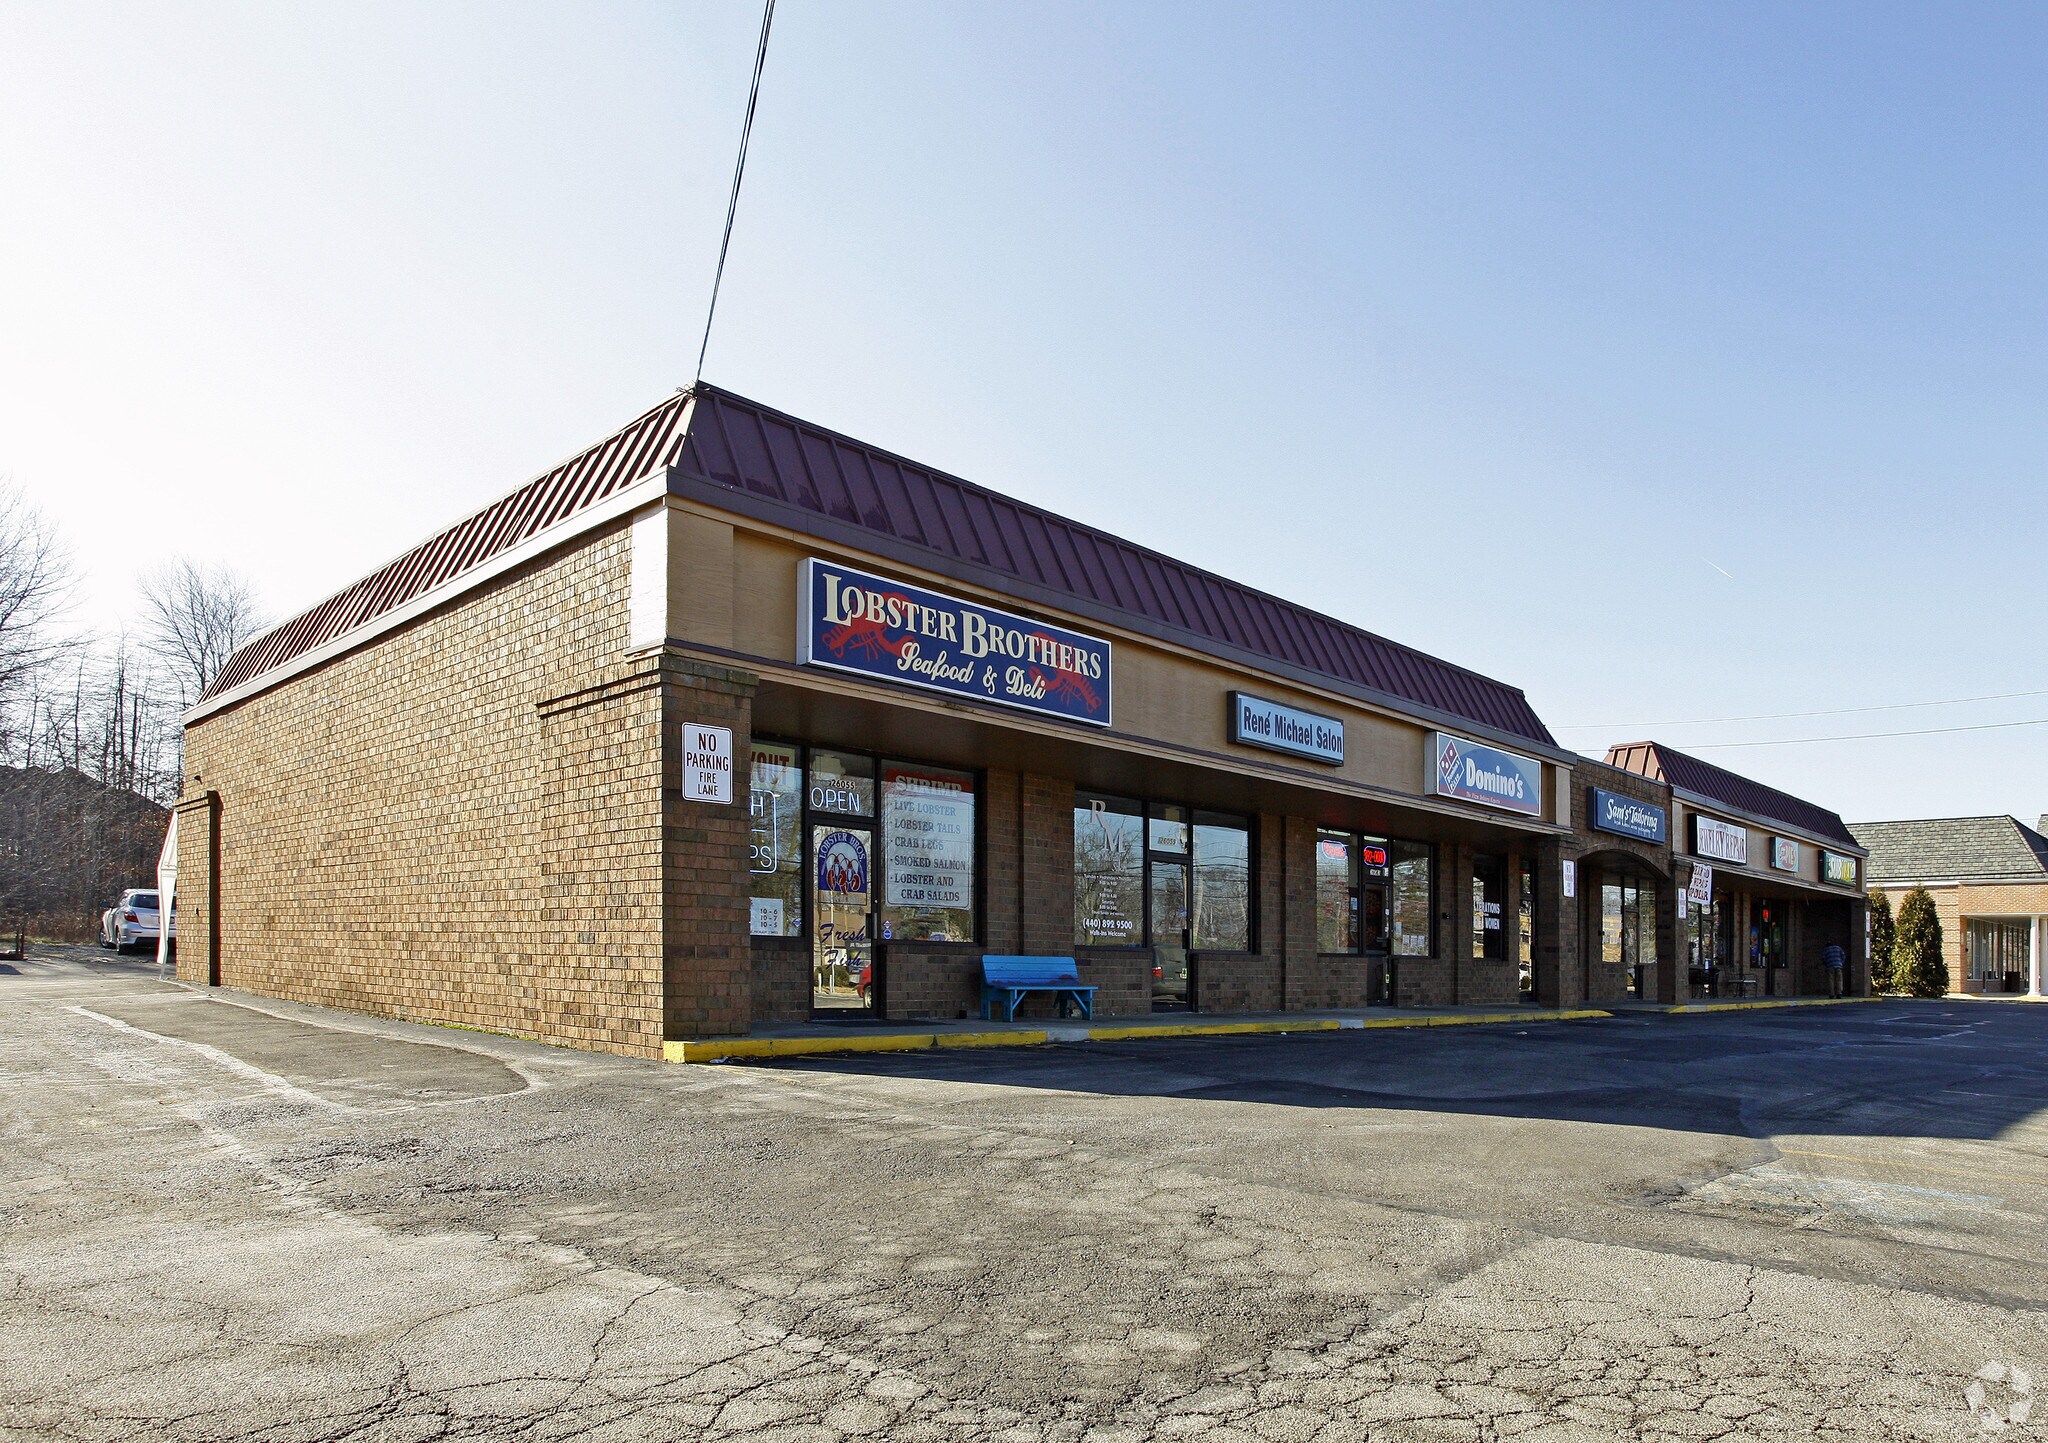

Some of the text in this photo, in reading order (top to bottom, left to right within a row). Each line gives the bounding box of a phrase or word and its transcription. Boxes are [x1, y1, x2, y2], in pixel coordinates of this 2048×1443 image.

[823, 573, 1101, 680] LOBSTER BROTHERS
[897, 642, 1046, 700] Seafood & Deli
[1244, 706, 1342, 753] René Michael Salon
[698, 733, 716, 752] NO
[686, 752, 729, 771] PARKING
[700, 772, 716, 784] FIRE
[831, 779, 855, 789] 26055
[1466, 758, 1523, 799] Domino's
[698, 784, 718, 796] LANE
[811, 787, 860, 812] OPEN
[895, 800, 956, 816] LIVE LOBSTER
[1607, 799, 1658, 832] Sam's Tailoring
[895, 819, 960, 834] LOBSTER TAILS
[820, 833, 848, 859] LOBSTER
[895, 837, 944, 850] CRAB LEGS
[895, 855, 966, 870] SMOKED SALMON
[895, 873, 954, 886] LOBSTER AND
[901, 889, 959, 901] CRAB SALADS
[820, 923, 866, 943] Fresh
[1082, 918, 1133, 929] (440) 892 9500
[824, 949, 862, 970] Fish
